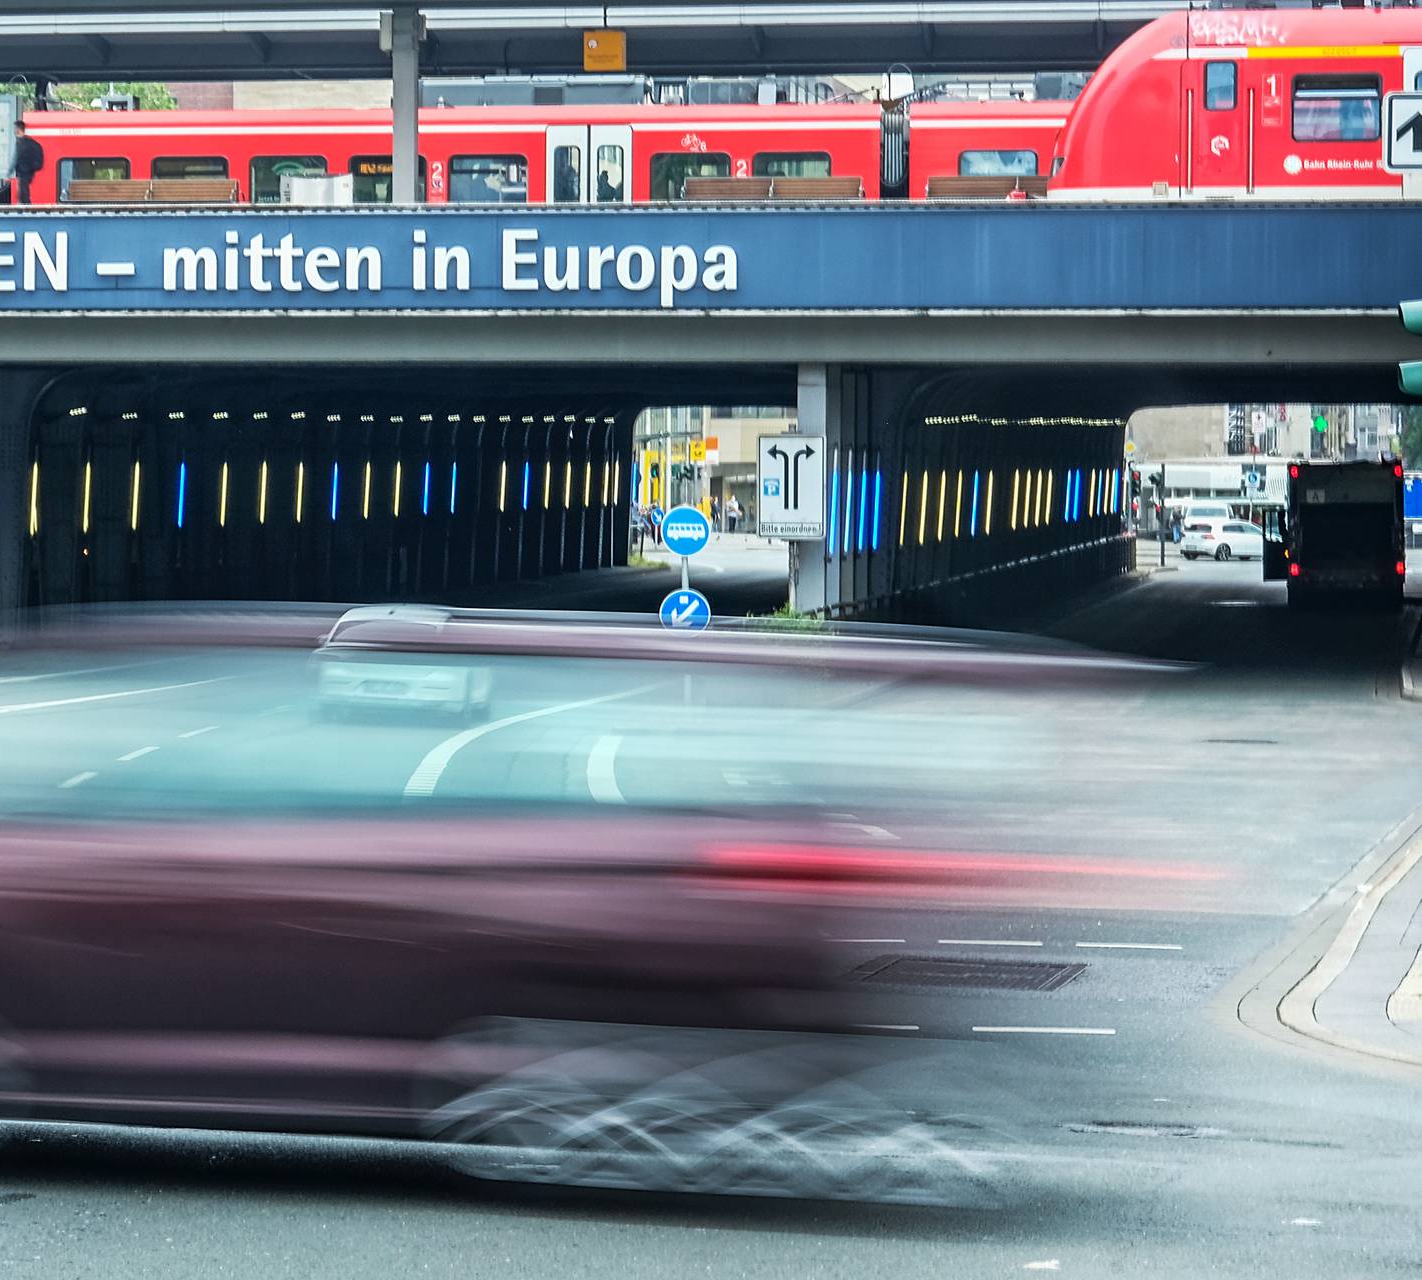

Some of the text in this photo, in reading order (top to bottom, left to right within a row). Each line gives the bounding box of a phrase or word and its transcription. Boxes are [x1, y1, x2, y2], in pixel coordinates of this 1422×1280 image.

[1266, 74, 1276, 97] 1
[431, 163, 443, 180] 2
[736, 158, 748, 177] 2
[1303, 159, 1326, 170] Bahn
[1327, 159, 1374, 170] Rhein-Ruhr
[162, 230, 382, 293] mitten
[412, 229, 471, 292] in
[501, 228, 739, 309] Europa
[761, 523, 779, 534] Bitte
